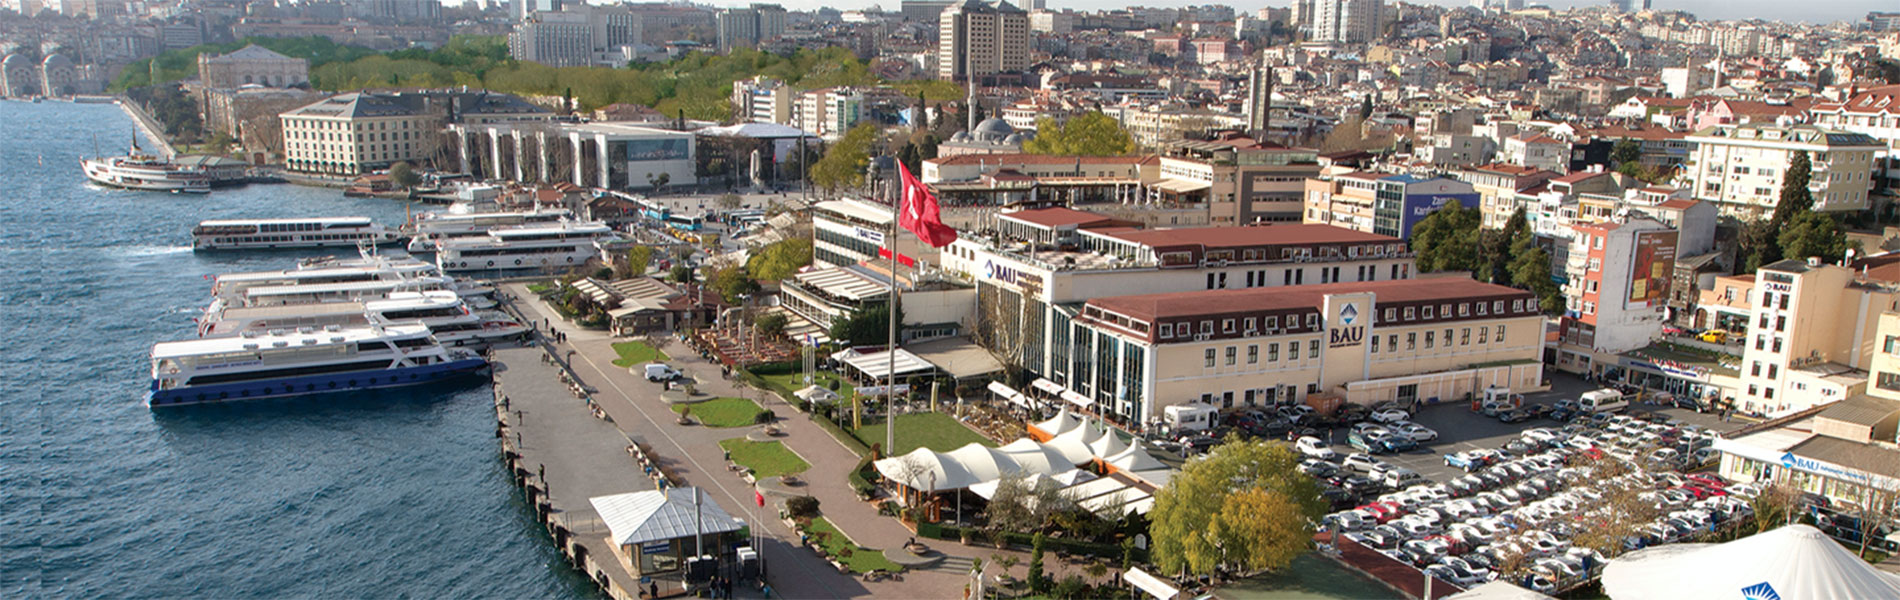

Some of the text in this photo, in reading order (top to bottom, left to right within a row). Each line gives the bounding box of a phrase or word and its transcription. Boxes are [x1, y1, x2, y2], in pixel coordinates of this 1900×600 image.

[996, 264, 1016, 284] BAU
[1773, 283, 1791, 292] BAU
[1330, 326, 1363, 343] BAU
[1797, 458, 1819, 471] BAU
